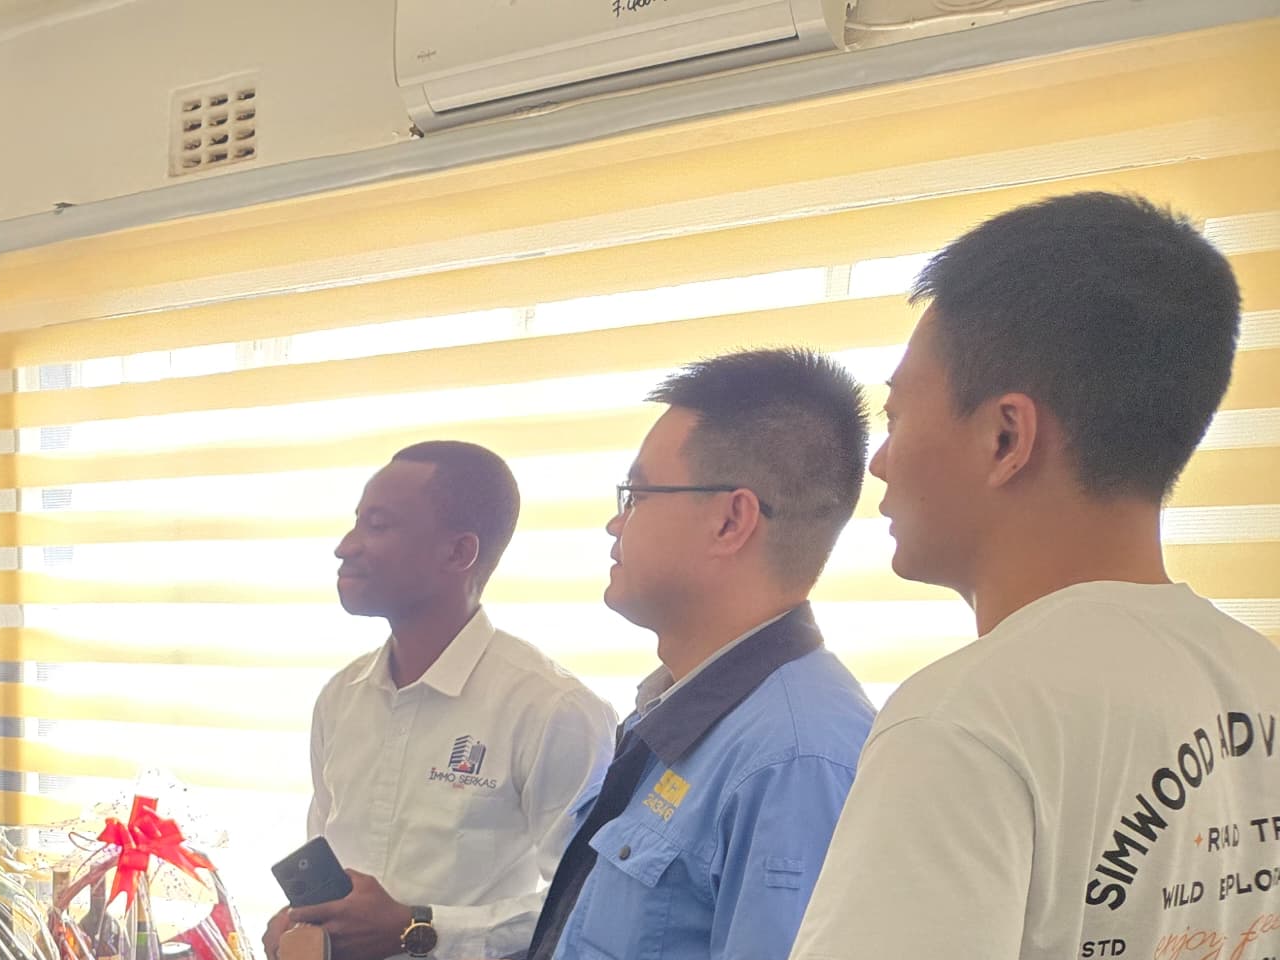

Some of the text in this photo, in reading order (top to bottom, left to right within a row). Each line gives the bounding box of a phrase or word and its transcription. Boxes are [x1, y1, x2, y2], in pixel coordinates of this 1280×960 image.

[459, 774, 497, 790] SERKAS
[1085, 728, 1214, 911] SIMWOOD
[1162, 881, 1204, 910] WILD
[1081, 938, 1127, 958] STD
